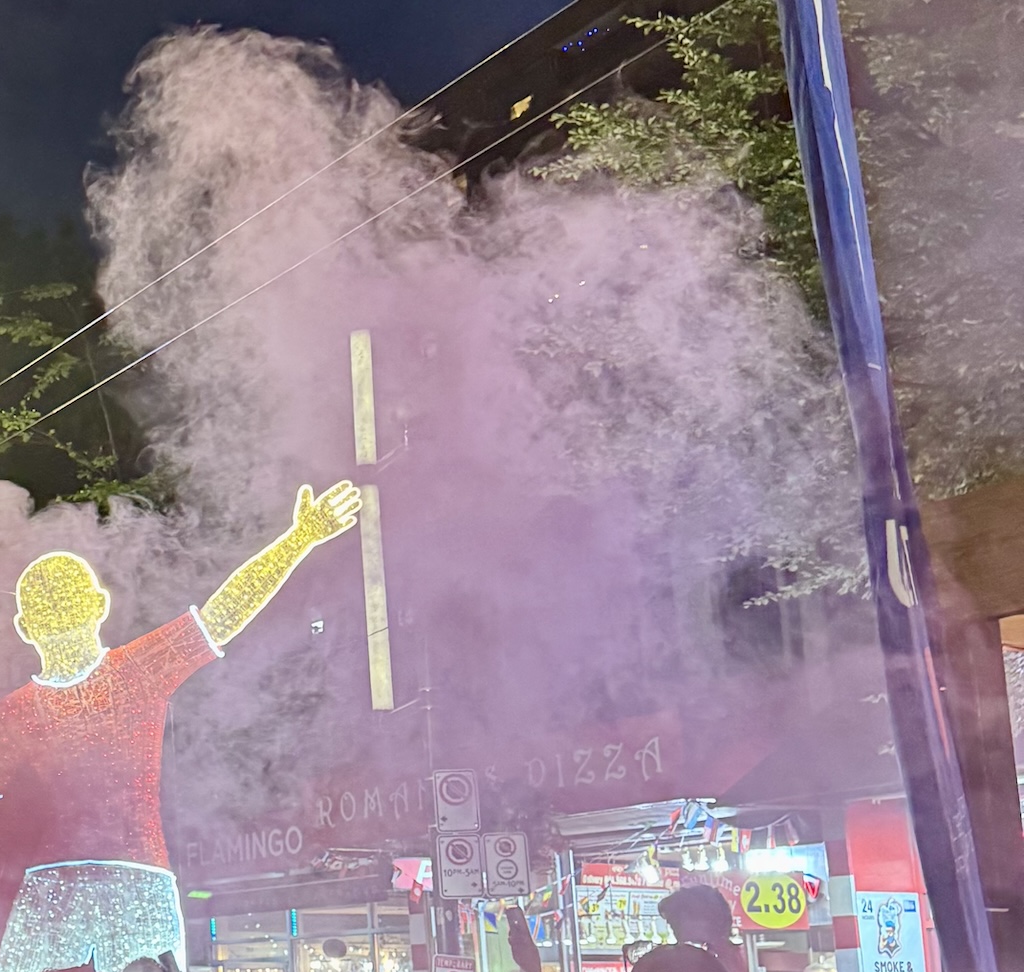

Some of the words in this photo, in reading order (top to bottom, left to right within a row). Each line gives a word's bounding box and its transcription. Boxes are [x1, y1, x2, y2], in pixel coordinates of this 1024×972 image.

[185, 826, 303, 867] FLAMINGO
[745, 881, 802, 914] 2.38
[861, 899, 873, 913] 24
[874, 961, 904, 972] SMOKE
[906, 962, 914, 972] &
